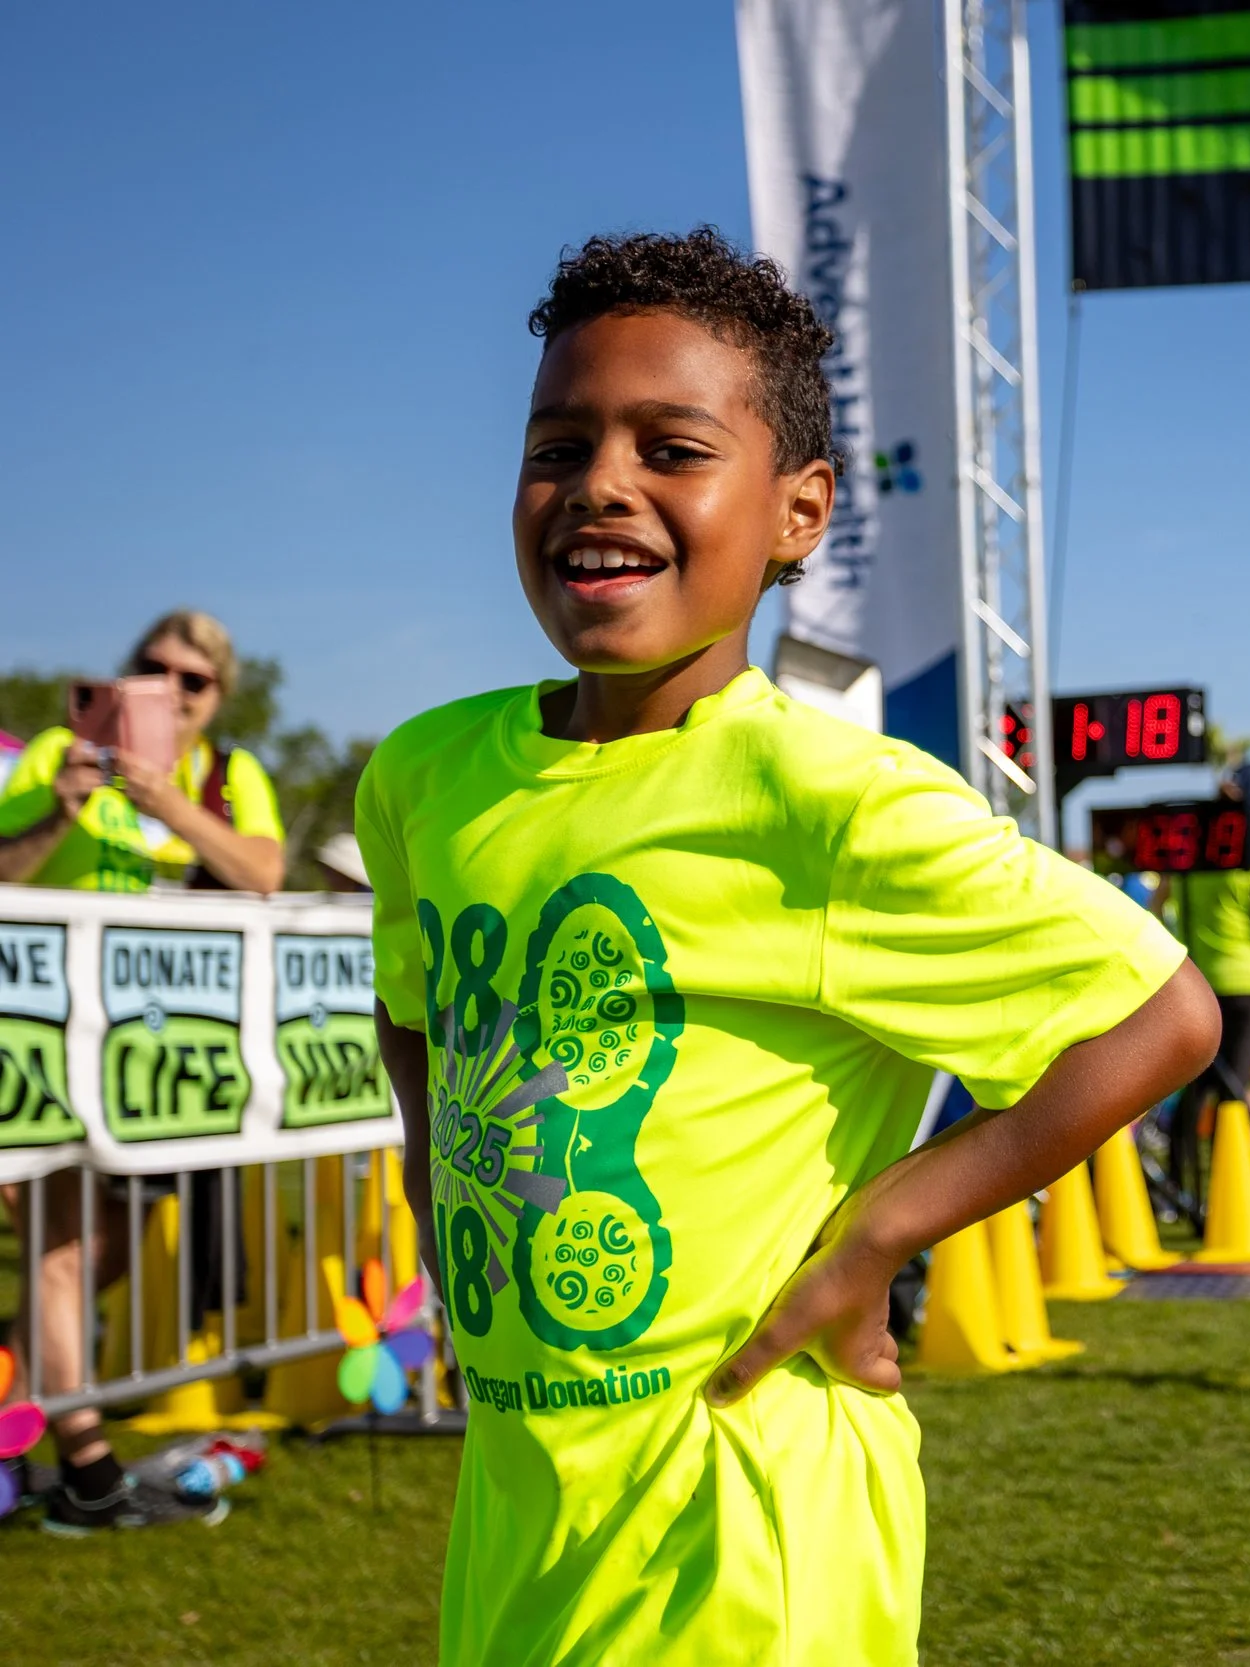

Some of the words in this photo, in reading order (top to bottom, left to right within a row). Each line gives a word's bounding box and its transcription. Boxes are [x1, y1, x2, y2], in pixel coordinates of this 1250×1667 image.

[114, 947, 232, 988] DONATE
[286, 951, 373, 989] DONE
[120, 1046, 236, 1119] LIFE
[432, 1086, 512, 1188] 2025
[466, 1366, 523, 1413] Organ
[524, 1364, 672, 1411] Donation
